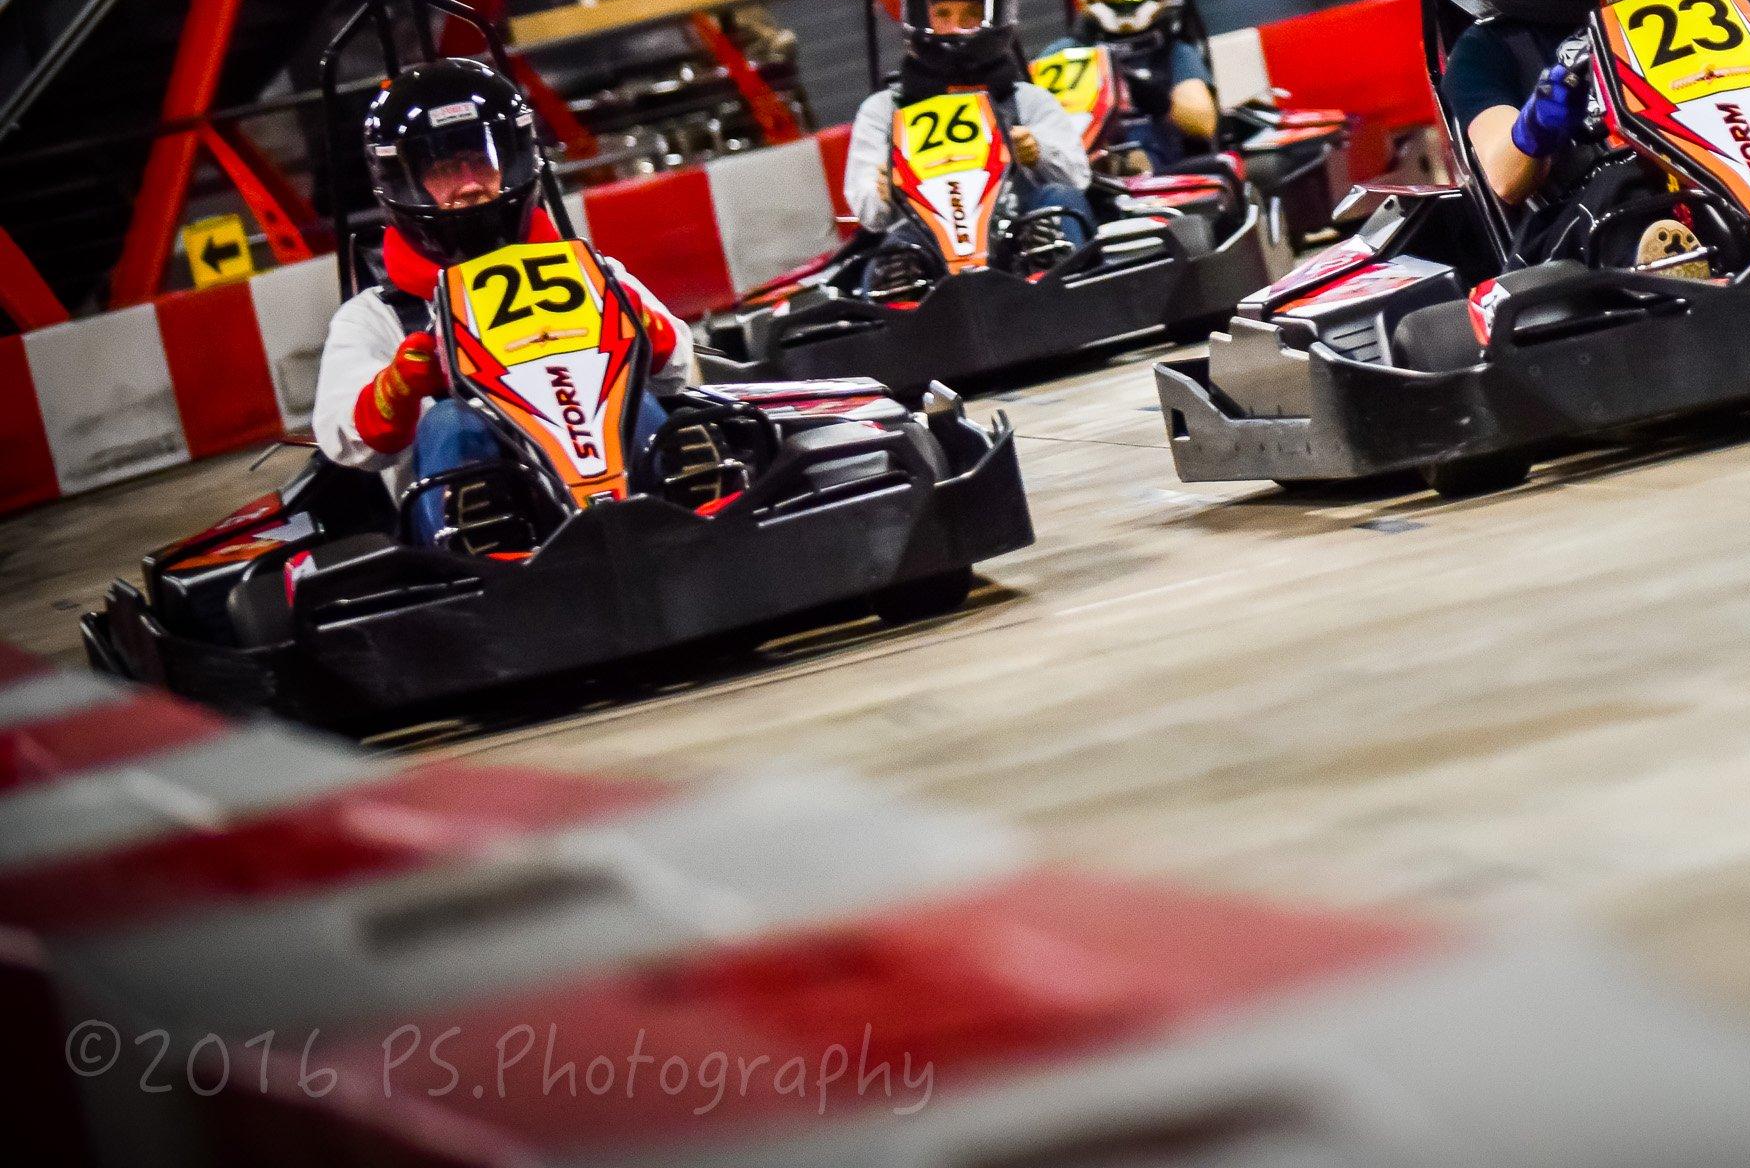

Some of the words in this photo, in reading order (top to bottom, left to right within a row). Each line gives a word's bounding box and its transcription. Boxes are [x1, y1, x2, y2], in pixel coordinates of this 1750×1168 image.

[1040, 56, 1092, 94] 27
[910, 103, 979, 153] 26
[948, 180, 971, 244] STORM
[472, 253, 586, 331] 25
[545, 364, 602, 460] STORM
